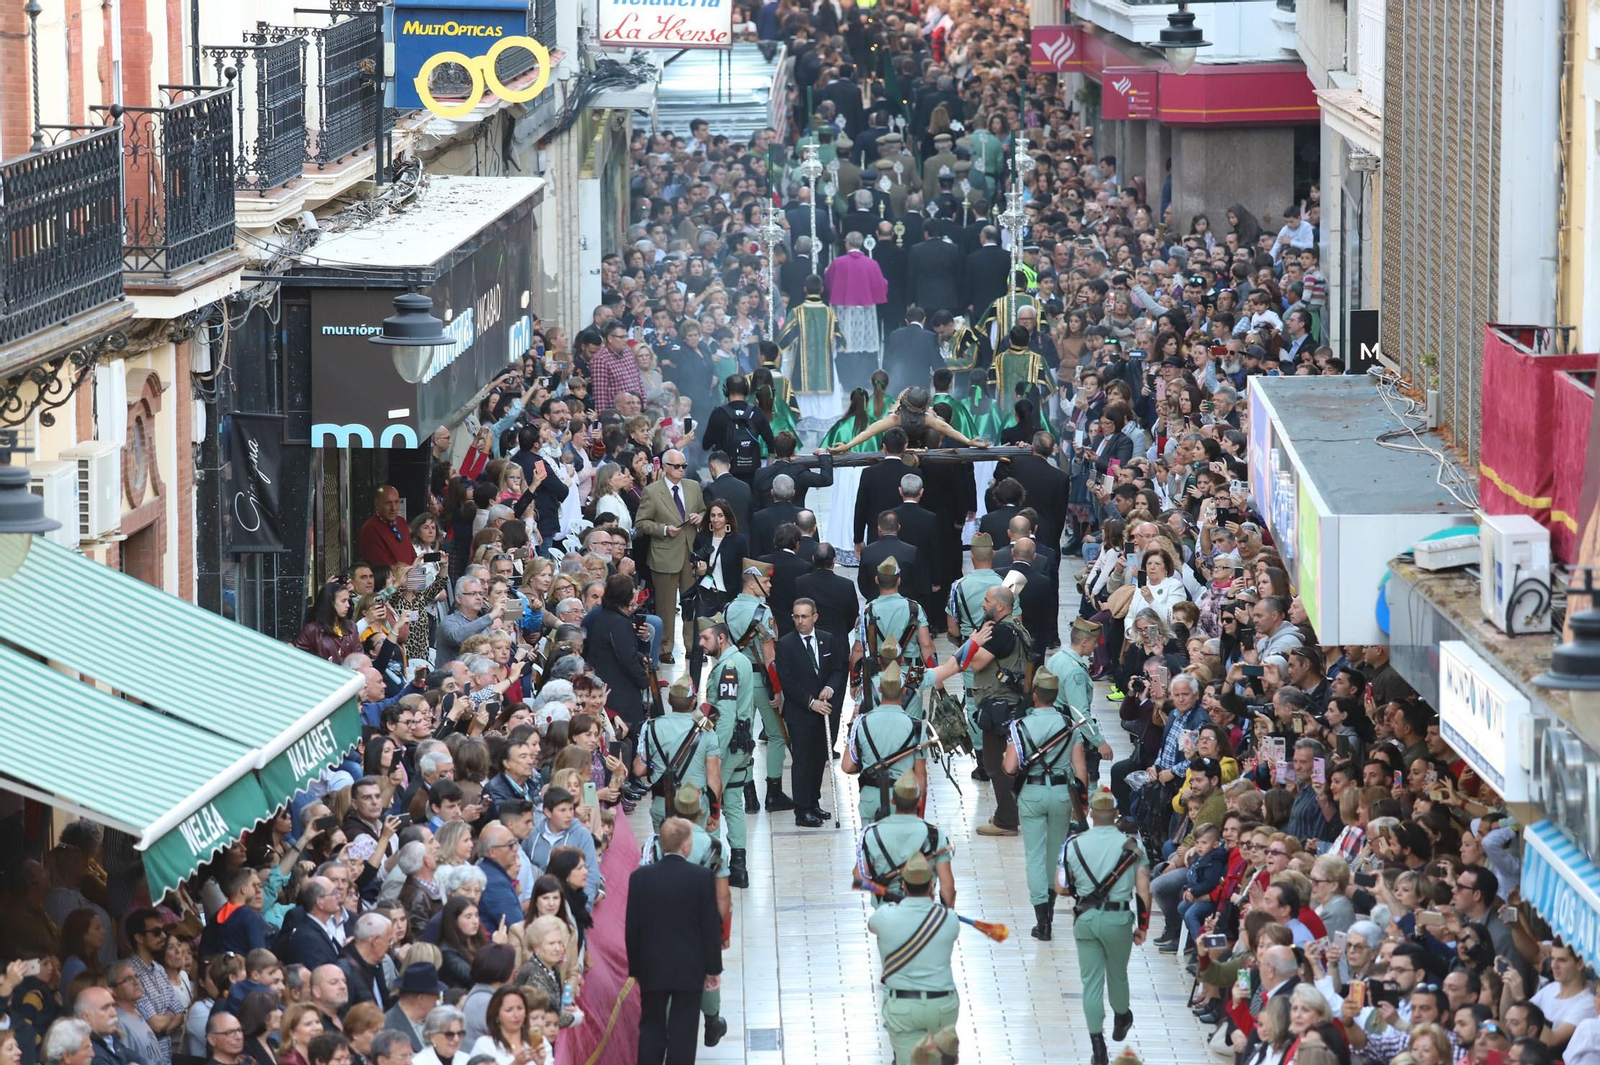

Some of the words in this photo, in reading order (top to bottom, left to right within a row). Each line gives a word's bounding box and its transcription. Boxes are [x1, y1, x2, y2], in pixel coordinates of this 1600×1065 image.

[604, 12, 642, 40] La
[719, 683, 738, 697] PM
[286, 718, 338, 782] NAZARET
